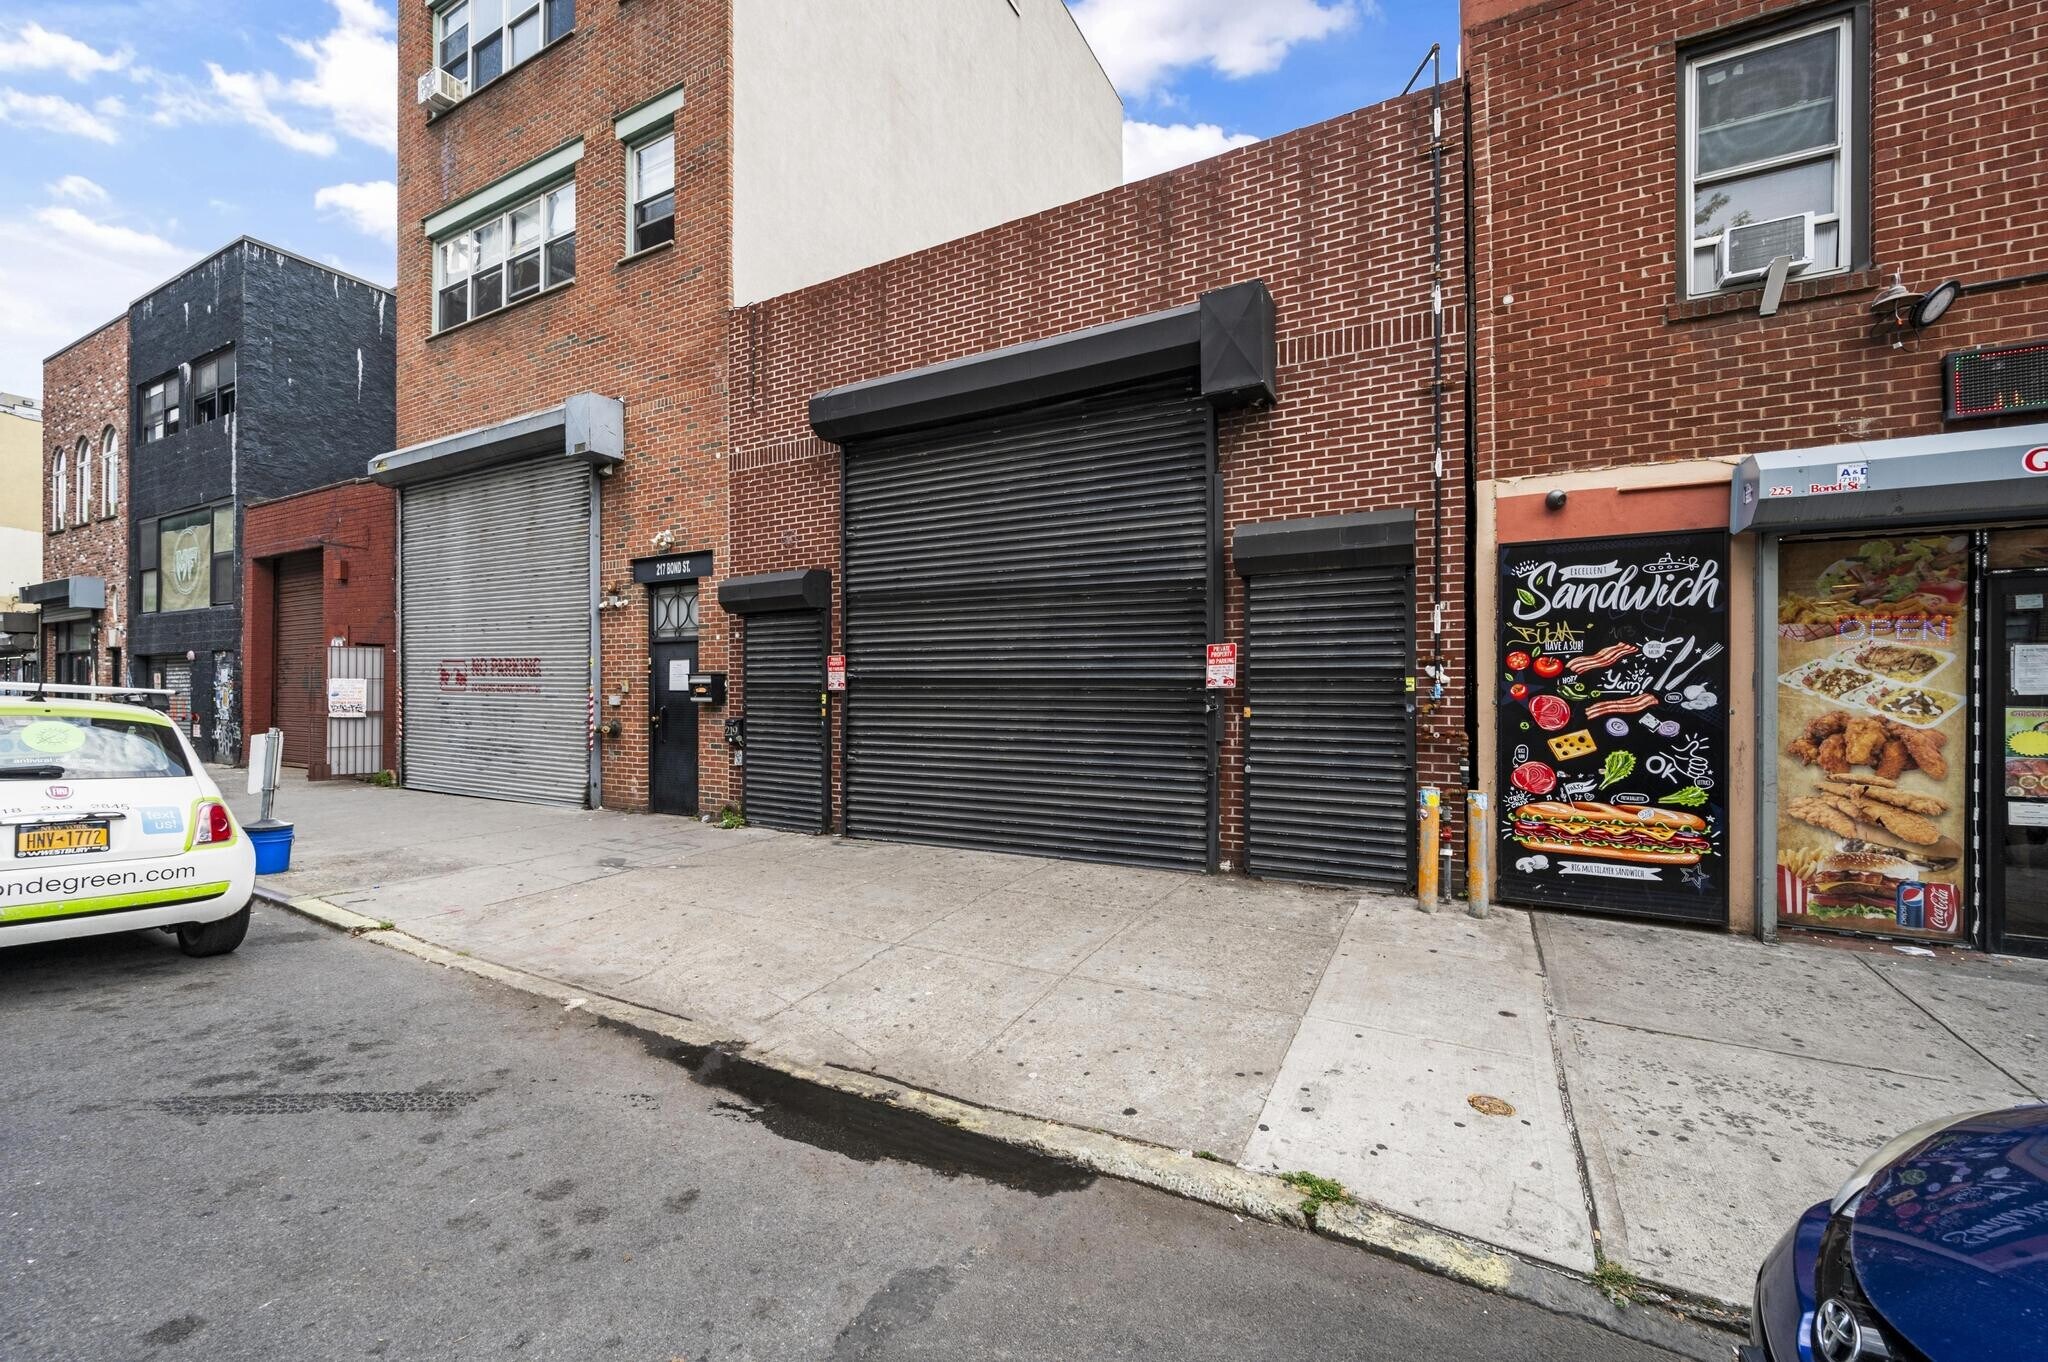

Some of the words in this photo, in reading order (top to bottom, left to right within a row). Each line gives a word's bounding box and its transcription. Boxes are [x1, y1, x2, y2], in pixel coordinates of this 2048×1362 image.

[1841, 468, 1851, 477] A
[1769, 486, 1793, 496] 225
[1811, 483, 1842, 493] Bond
[1848, 481, 1859, 490] St
[656, 563, 666, 576] 217
[666, 561, 682, 575] BOND
[682, 560, 691, 573] ST.
[1570, 566, 1608, 576] EXCELLENT
[1513, 560, 1720, 621] Sandwich
[1839, 618, 1948, 641] OPEN
[1545, 641, 1561, 651] HAVE
[1563, 641, 1569, 650] A
[1569, 640, 1584, 651] SUB!
[1604, 669, 1654, 695] Yum!
[725, 726, 738, 736] 219
[1645, 755, 1678, 784] OK
[146, 810, 176, 820] text
[155, 819, 177, 830] us!
[1571, 863, 1581, 872] BIG
[1581, 864, 1615, 875] MULTILAYER
[1615, 867, 1645, 878] SANDWICH
[0, 866, 195, 896] ndegreen.com
